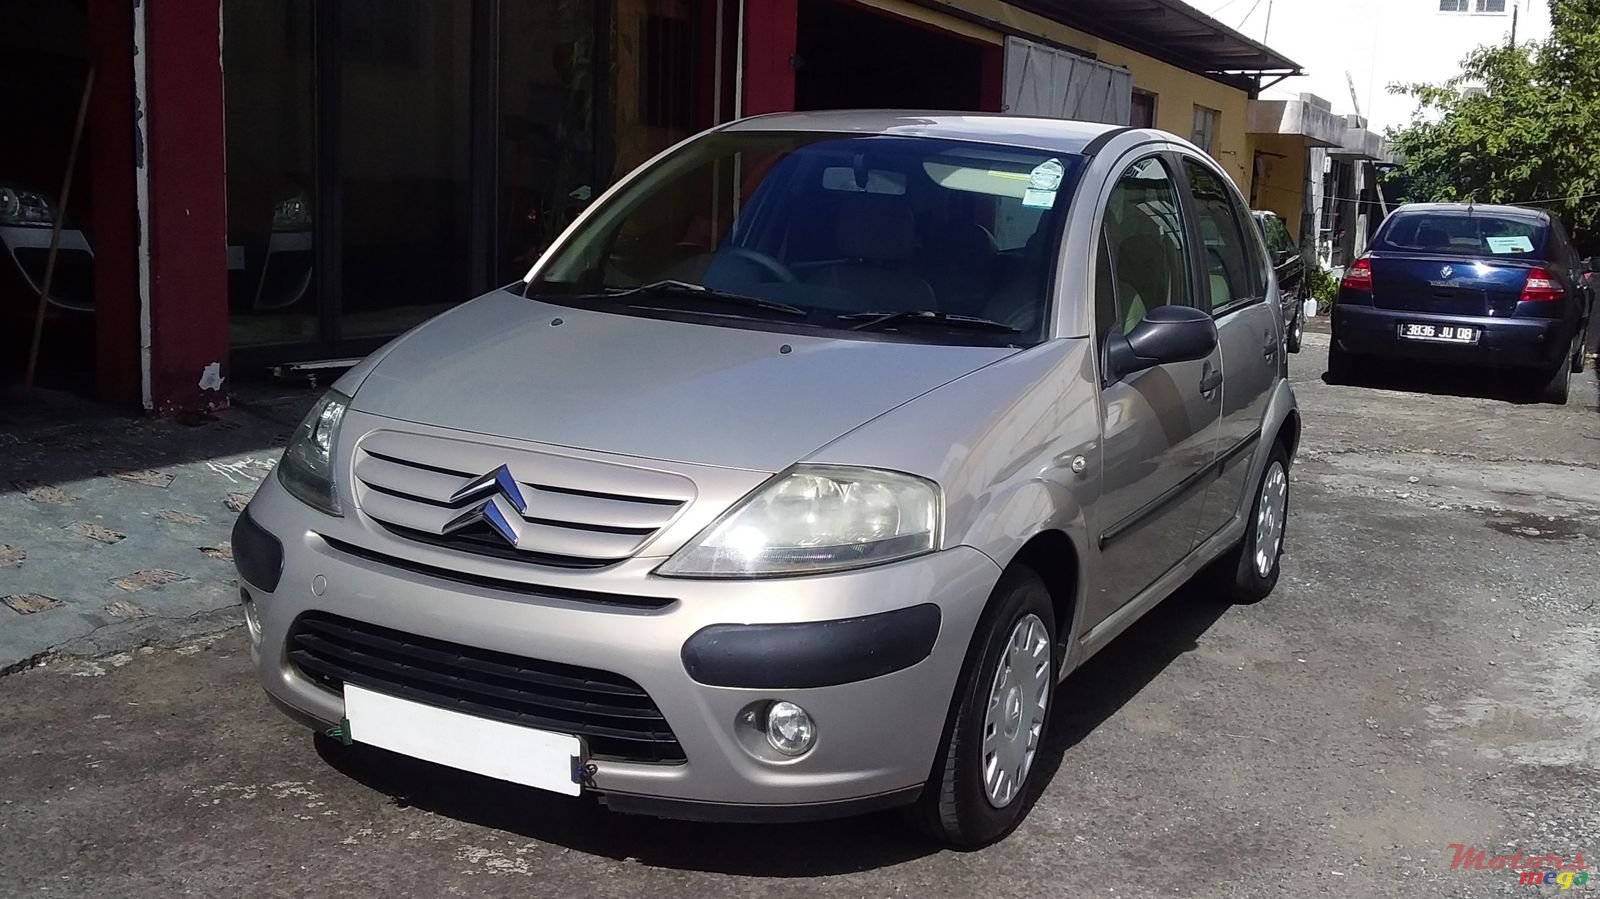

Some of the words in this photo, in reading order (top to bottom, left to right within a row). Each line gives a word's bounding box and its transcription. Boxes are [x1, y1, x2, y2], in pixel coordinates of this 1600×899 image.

[1407, 324, 1435, 336] 3836
[1438, 327, 1453, 338] JU
[1457, 328, 1472, 339] 08
